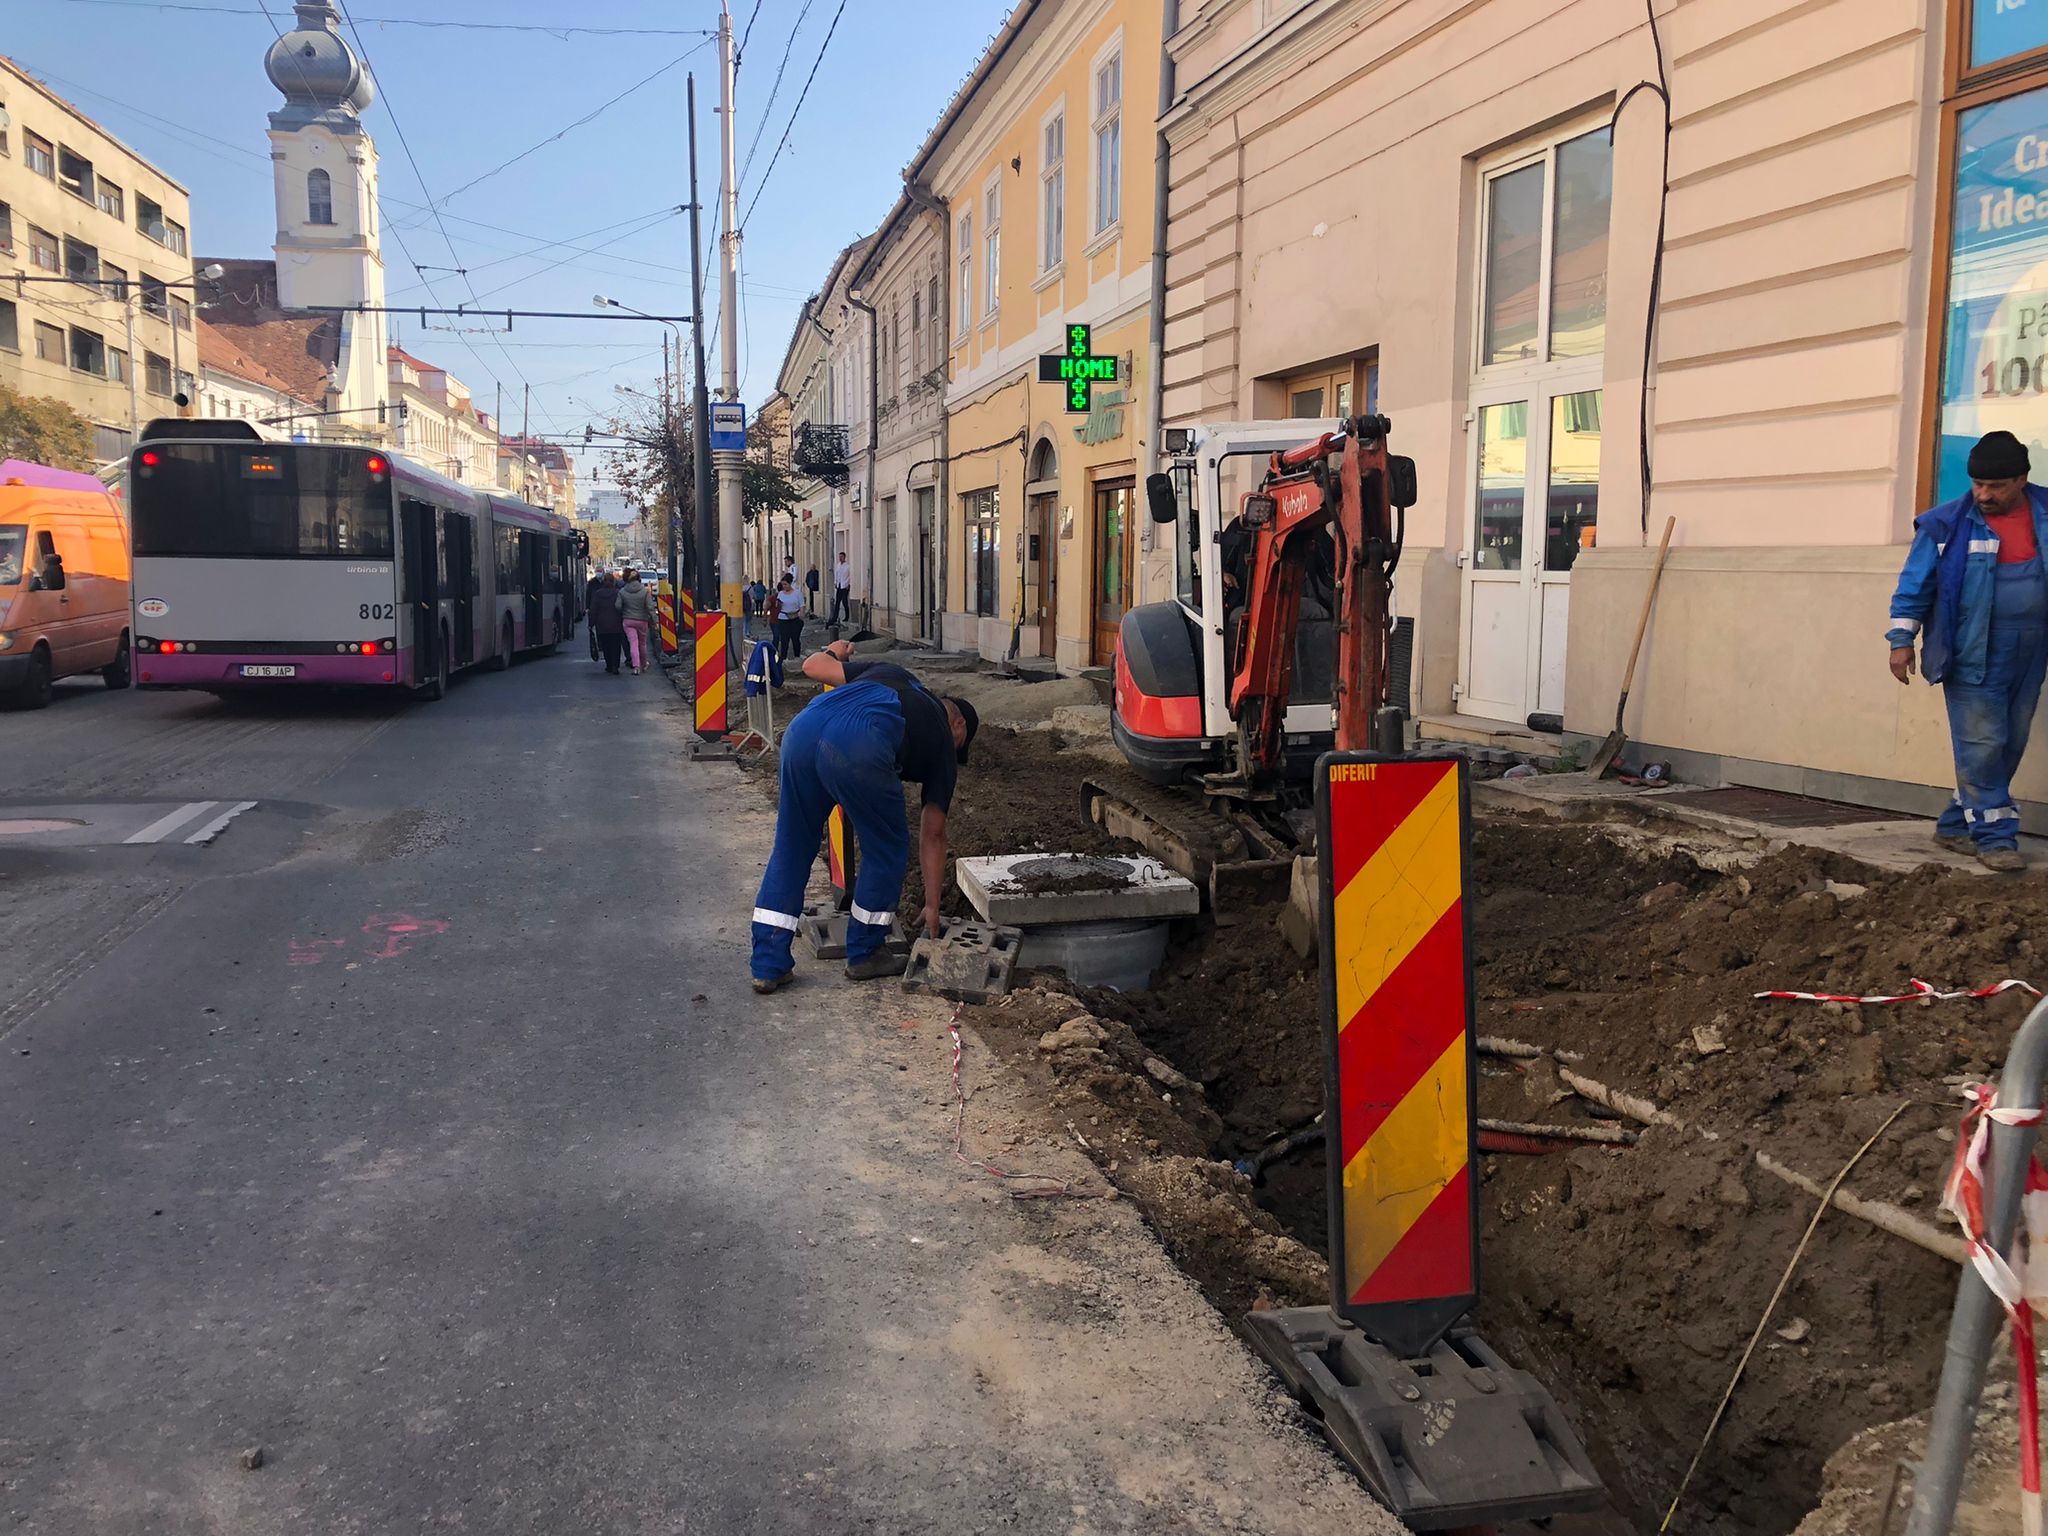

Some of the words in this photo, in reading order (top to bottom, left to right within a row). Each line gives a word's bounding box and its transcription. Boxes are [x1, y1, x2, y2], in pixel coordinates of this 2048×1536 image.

[1060, 358, 1114, 379] HOME
[359, 603, 394, 620] 802
[246, 666, 260, 676] CJ
[262, 666, 272, 676] 16
[274, 666, 292, 676] JAP
[1329, 763, 1377, 782] DIFERIT
